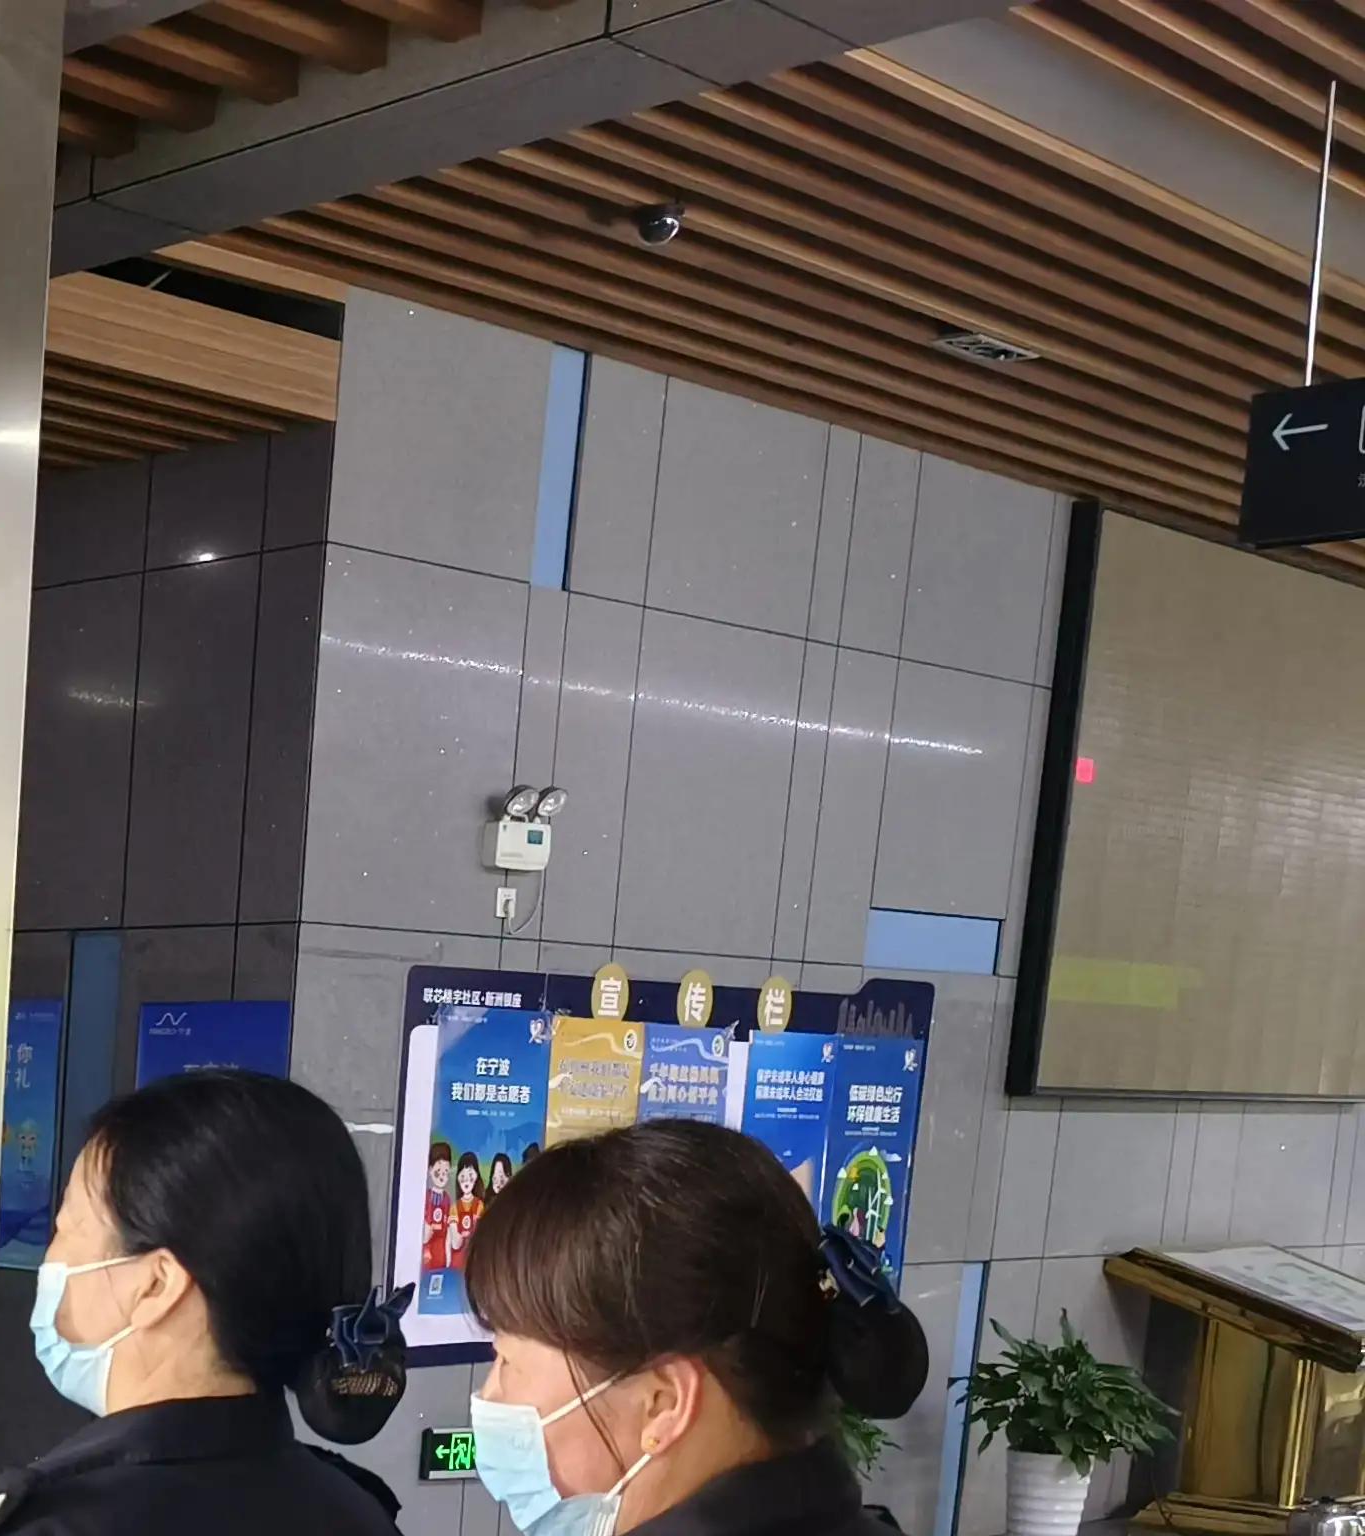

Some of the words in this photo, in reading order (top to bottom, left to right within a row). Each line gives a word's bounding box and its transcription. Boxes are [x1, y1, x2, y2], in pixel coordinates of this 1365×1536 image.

[598, 977, 785, 1026] 宣传栏
[476, 1057, 510, 1076] 在宁波
[451, 1082, 531, 1104] 我们都是志愿者
[849, 1084, 904, 1104] 低碳绿色出行
[846, 1105, 902, 1125] 环保健康生活
